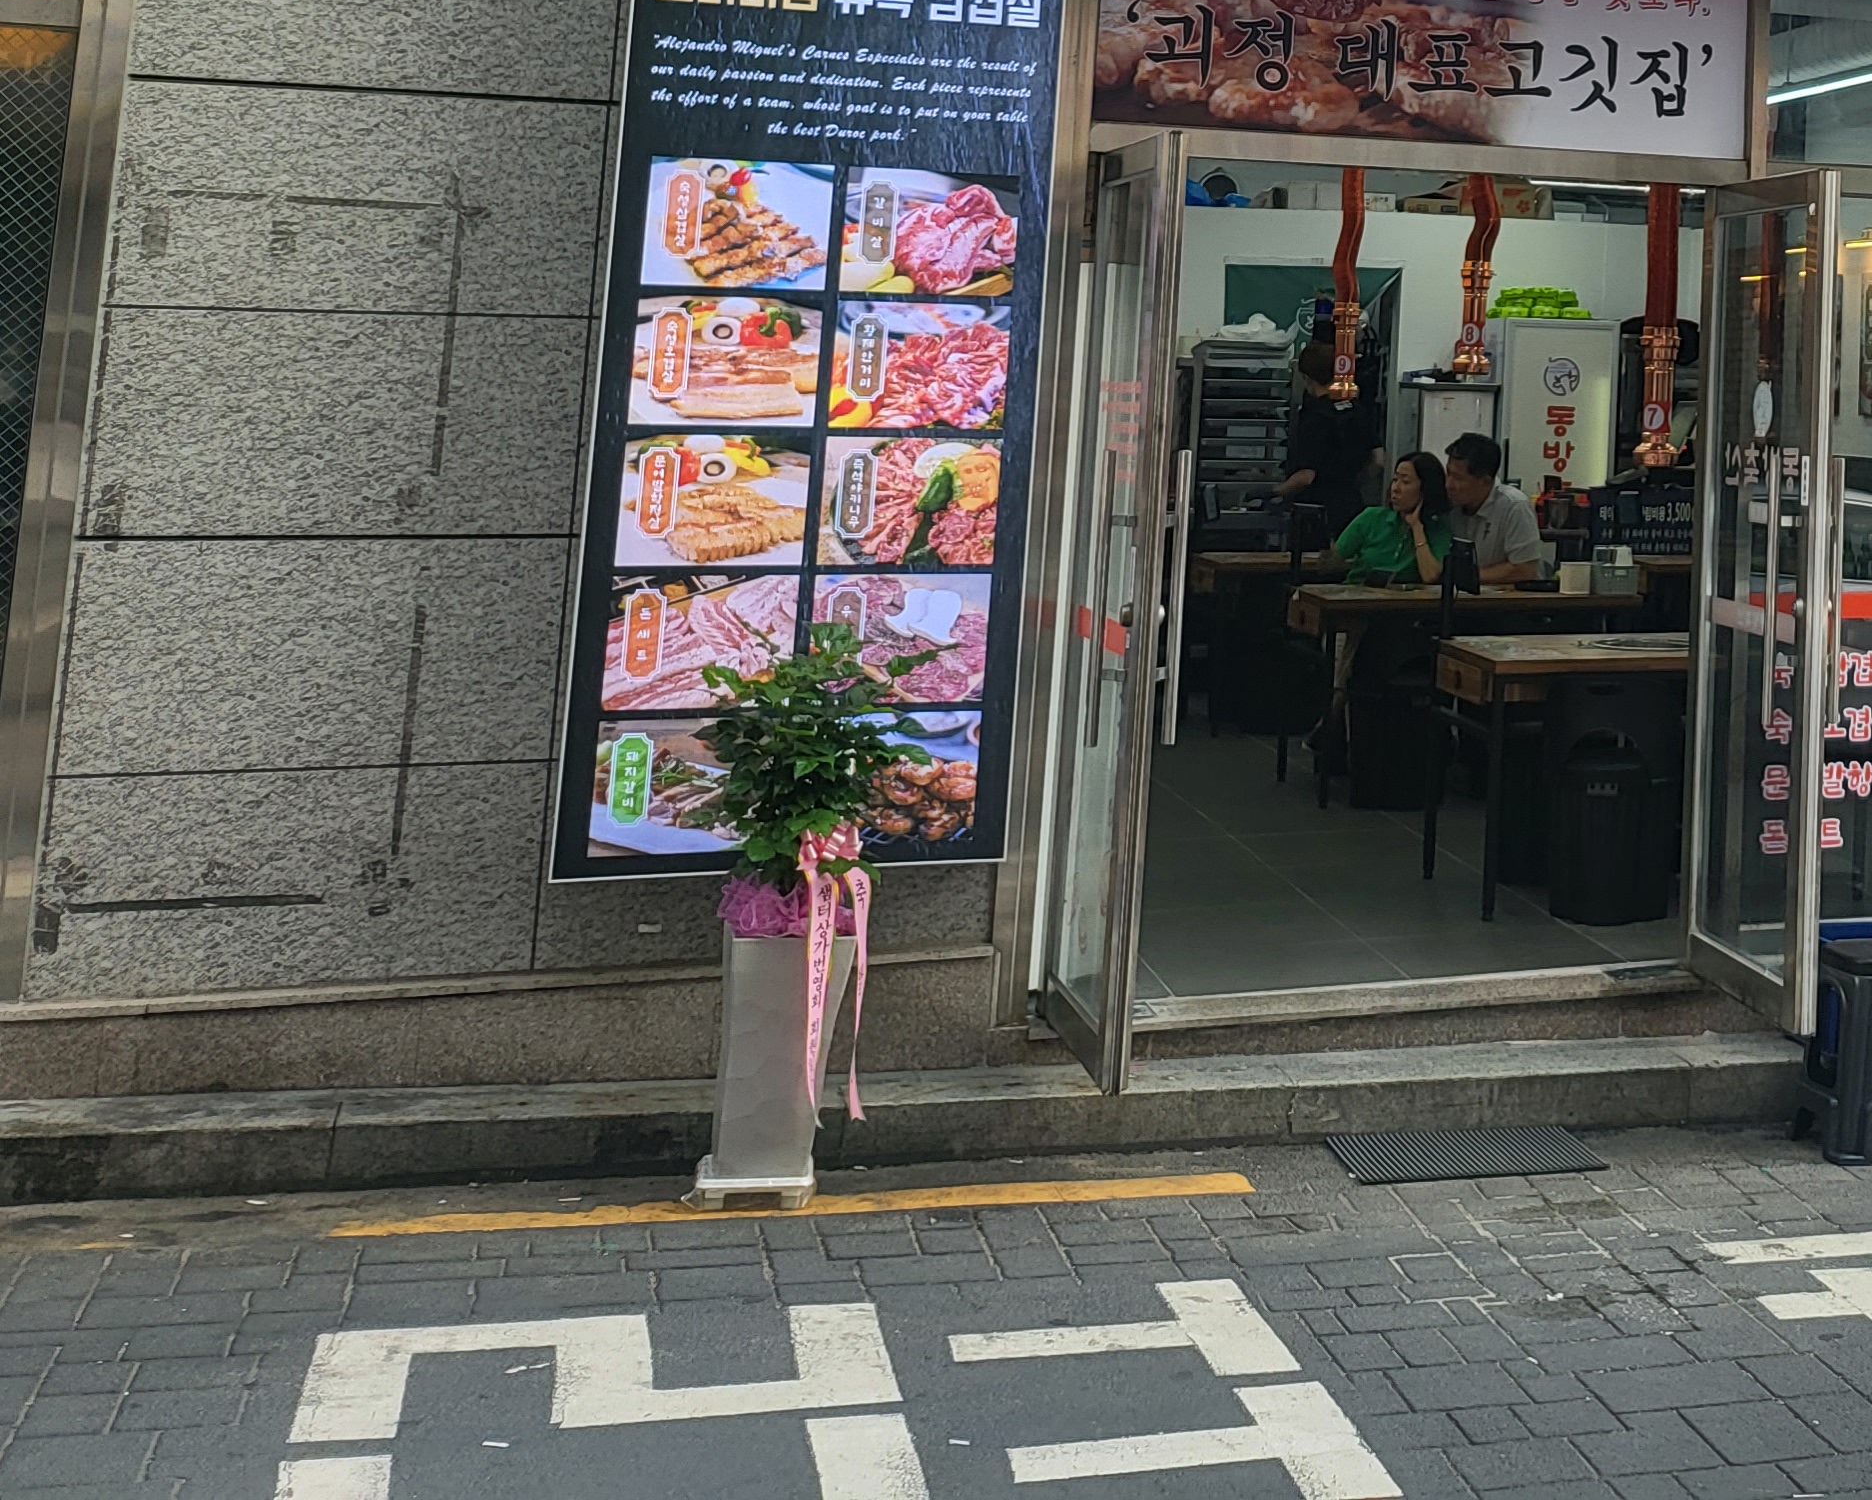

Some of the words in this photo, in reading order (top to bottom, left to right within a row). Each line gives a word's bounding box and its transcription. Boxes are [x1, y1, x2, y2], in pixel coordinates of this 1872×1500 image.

[802, 45, 850, 62] Carnes
[854, 47, 926, 68] Especiales
[930, 56, 953, 68] are
[957, 54, 977, 70] the
[982, 57, 1019, 73] result
[1023, 60, 1037, 77] of
[651, 64, 675, 76] our
[680, 64, 717, 82] daily
[721, 66, 775, 83] passion
[779, 70, 805, 85] and
[810, 73, 884, 90] dedication.
[891, 76, 926, 92] Each
[929, 80, 963, 96] piece
[967, 83, 1032, 99] represents
[651, 88, 673, 102] the
[678, 89, 718, 108] effort
[723, 92, 738, 109] of
[743, 96, 752, 107] a
[802, 96, 842, 113] whose
[845, 100, 875, 118] goal
[880, 102, 893, 115] is
[898, 104, 912, 117] to
[915, 105, 938, 120] put
[943, 108, 958, 120] on
[962, 110, 992, 125] your
[995, 107, 1028, 123] table
[767, 122, 789, 136] the
[793, 122, 821, 138] best
[825, 123, 866, 140] Duroc
[869, 195, 888, 250] 갈비살
[859, 324, 876, 388] 황제안거미
[1647, 408, 1658, 426] 7
